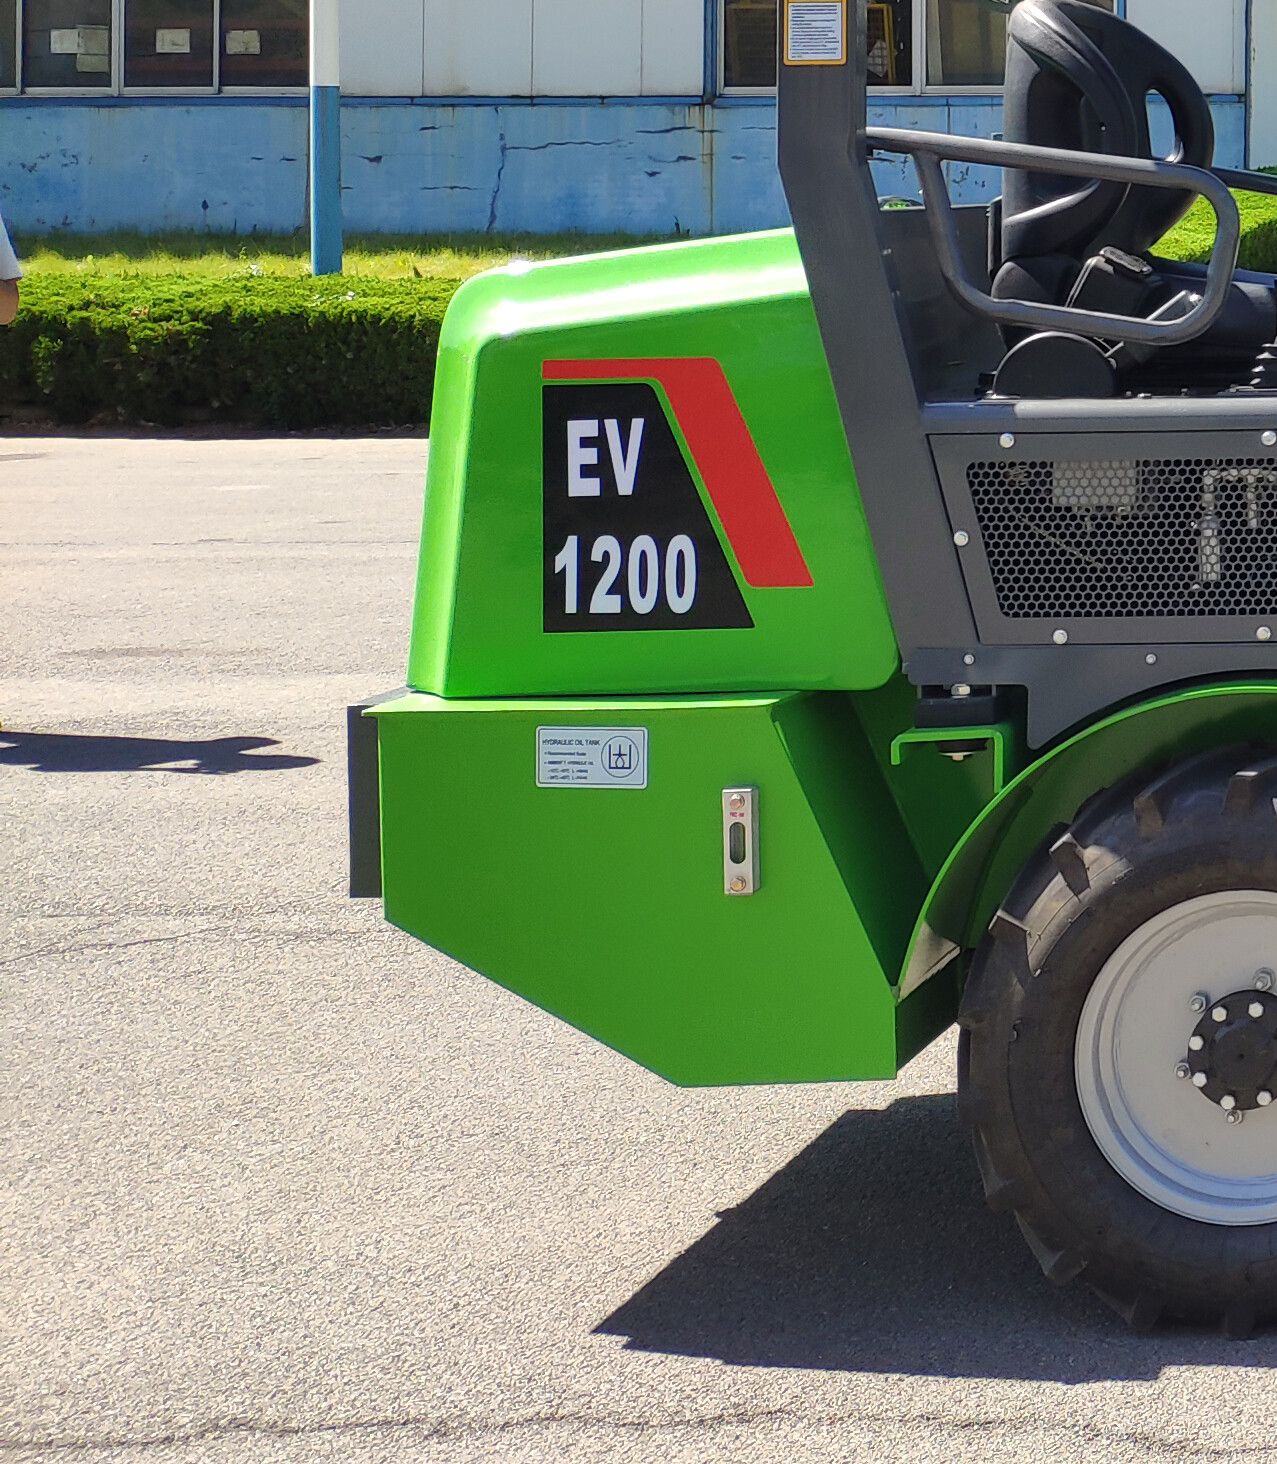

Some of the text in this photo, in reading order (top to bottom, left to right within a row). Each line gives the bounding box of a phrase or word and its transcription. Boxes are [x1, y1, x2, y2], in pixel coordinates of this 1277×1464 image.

[566, 417, 646, 498] EV
[554, 533, 698, 615] 1200
[542, 738, 574, 746] HYDRAULIC
[575, 739, 585, 747] OIL
